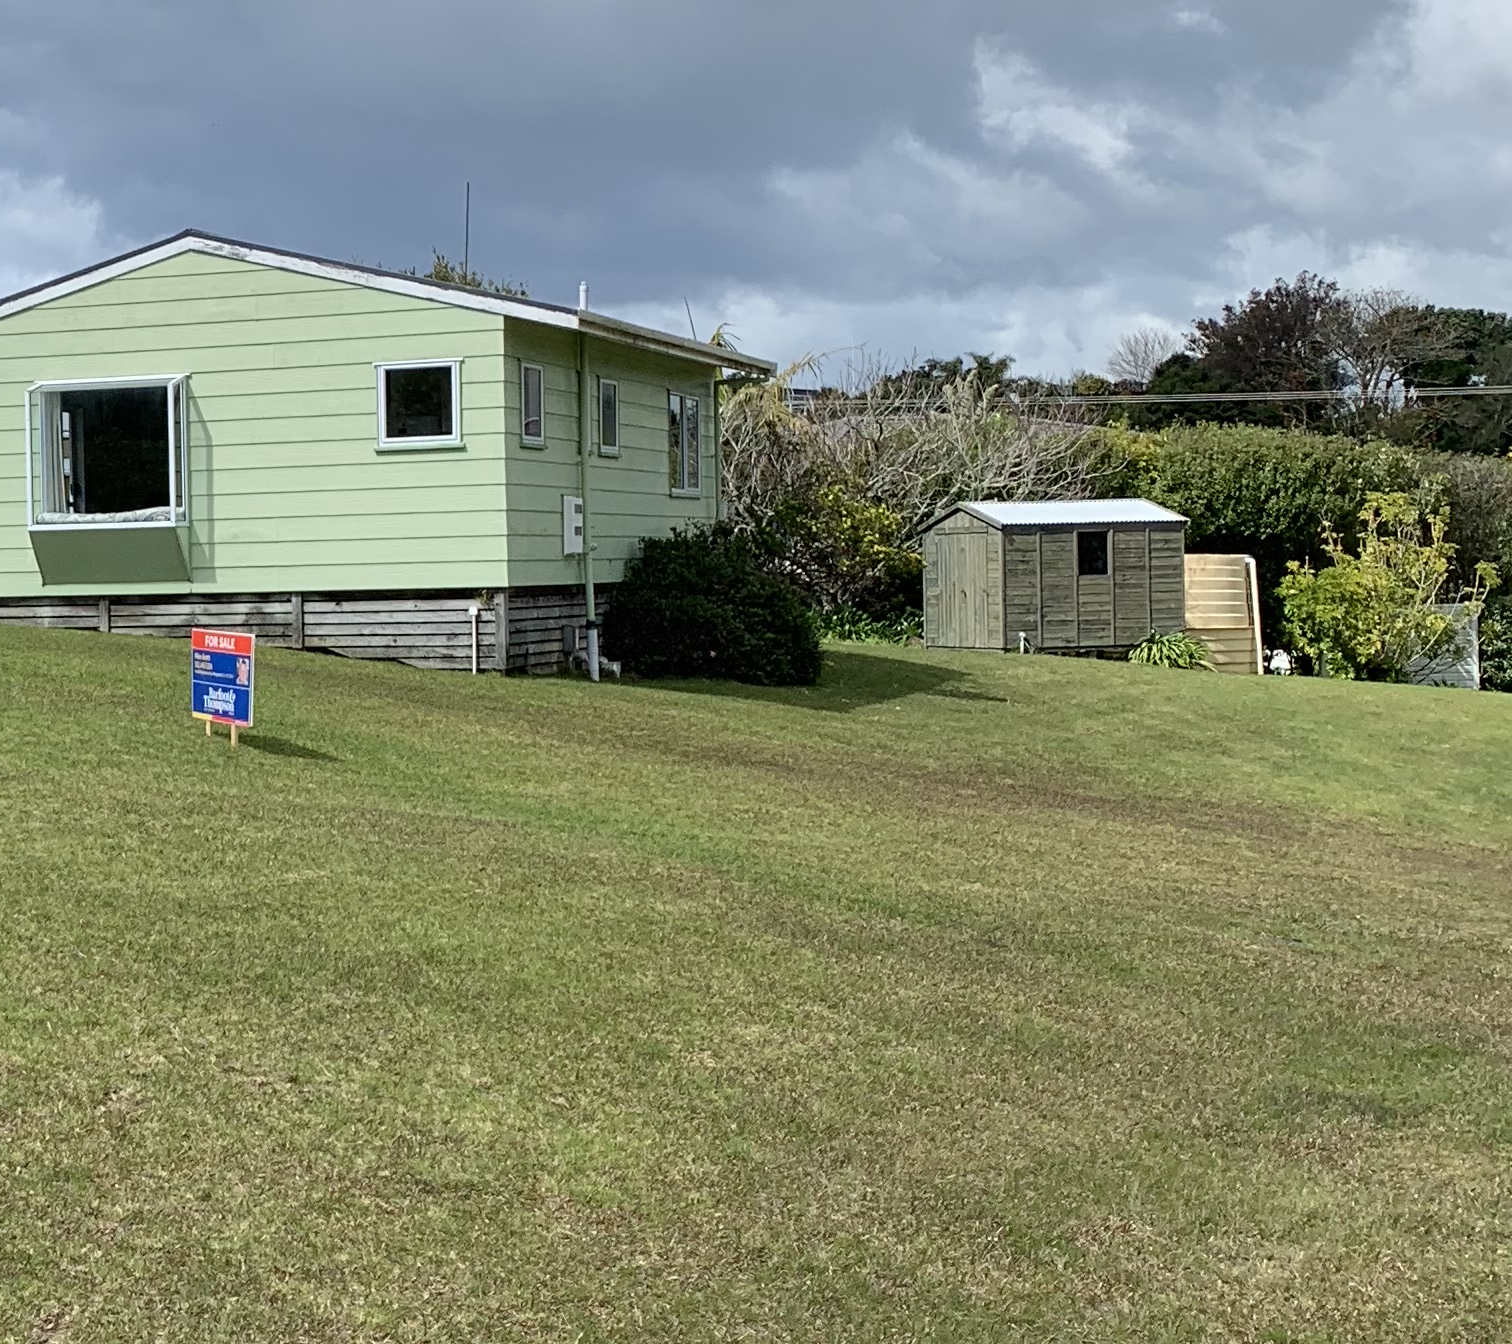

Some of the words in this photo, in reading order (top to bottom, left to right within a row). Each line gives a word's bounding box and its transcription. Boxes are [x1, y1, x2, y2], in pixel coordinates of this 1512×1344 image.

[205, 635, 218, 647] FOR
[219, 636, 235, 649] SALE
[203, 695, 234, 714] Thompson
